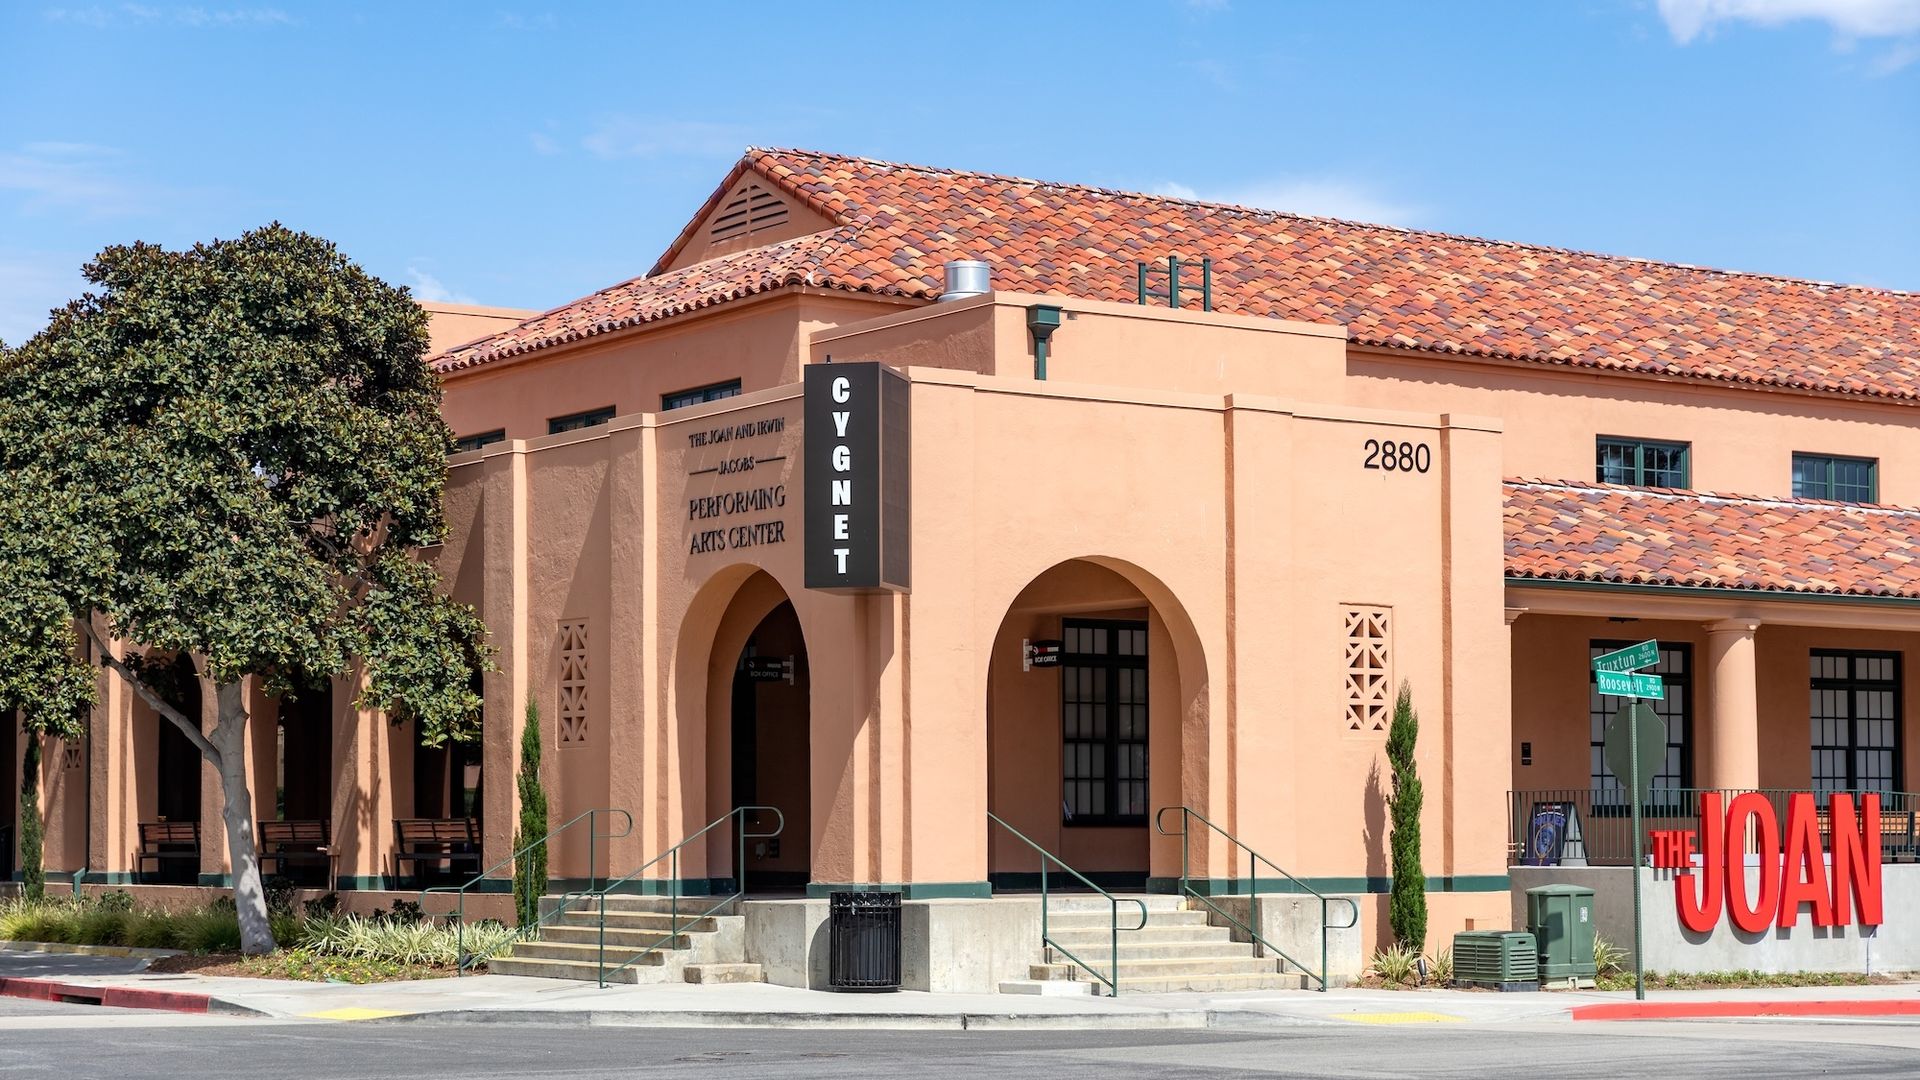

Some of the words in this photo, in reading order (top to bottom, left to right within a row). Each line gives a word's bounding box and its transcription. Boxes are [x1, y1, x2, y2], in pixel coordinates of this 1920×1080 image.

[689, 432, 708, 448] THE
[708, 426, 734, 445] JOAN
[735, 422, 756, 440] AND
[757, 417, 785, 436] IRWIN
[718, 456, 755, 475] JACOBS
[1363, 438, 1431, 474] 2880
[830, 376, 852, 574] CYGNET
[689, 485, 786, 521] PERFORMING
[689, 529, 726, 555] ARTS
[728, 520, 786, 549] CENTER
[1597, 654, 1636, 670] Truxtun
[1599, 674, 1644, 693] Roosevelt
[1648, 829, 1697, 868] THE
[1674, 792, 1884, 933] JOAN
